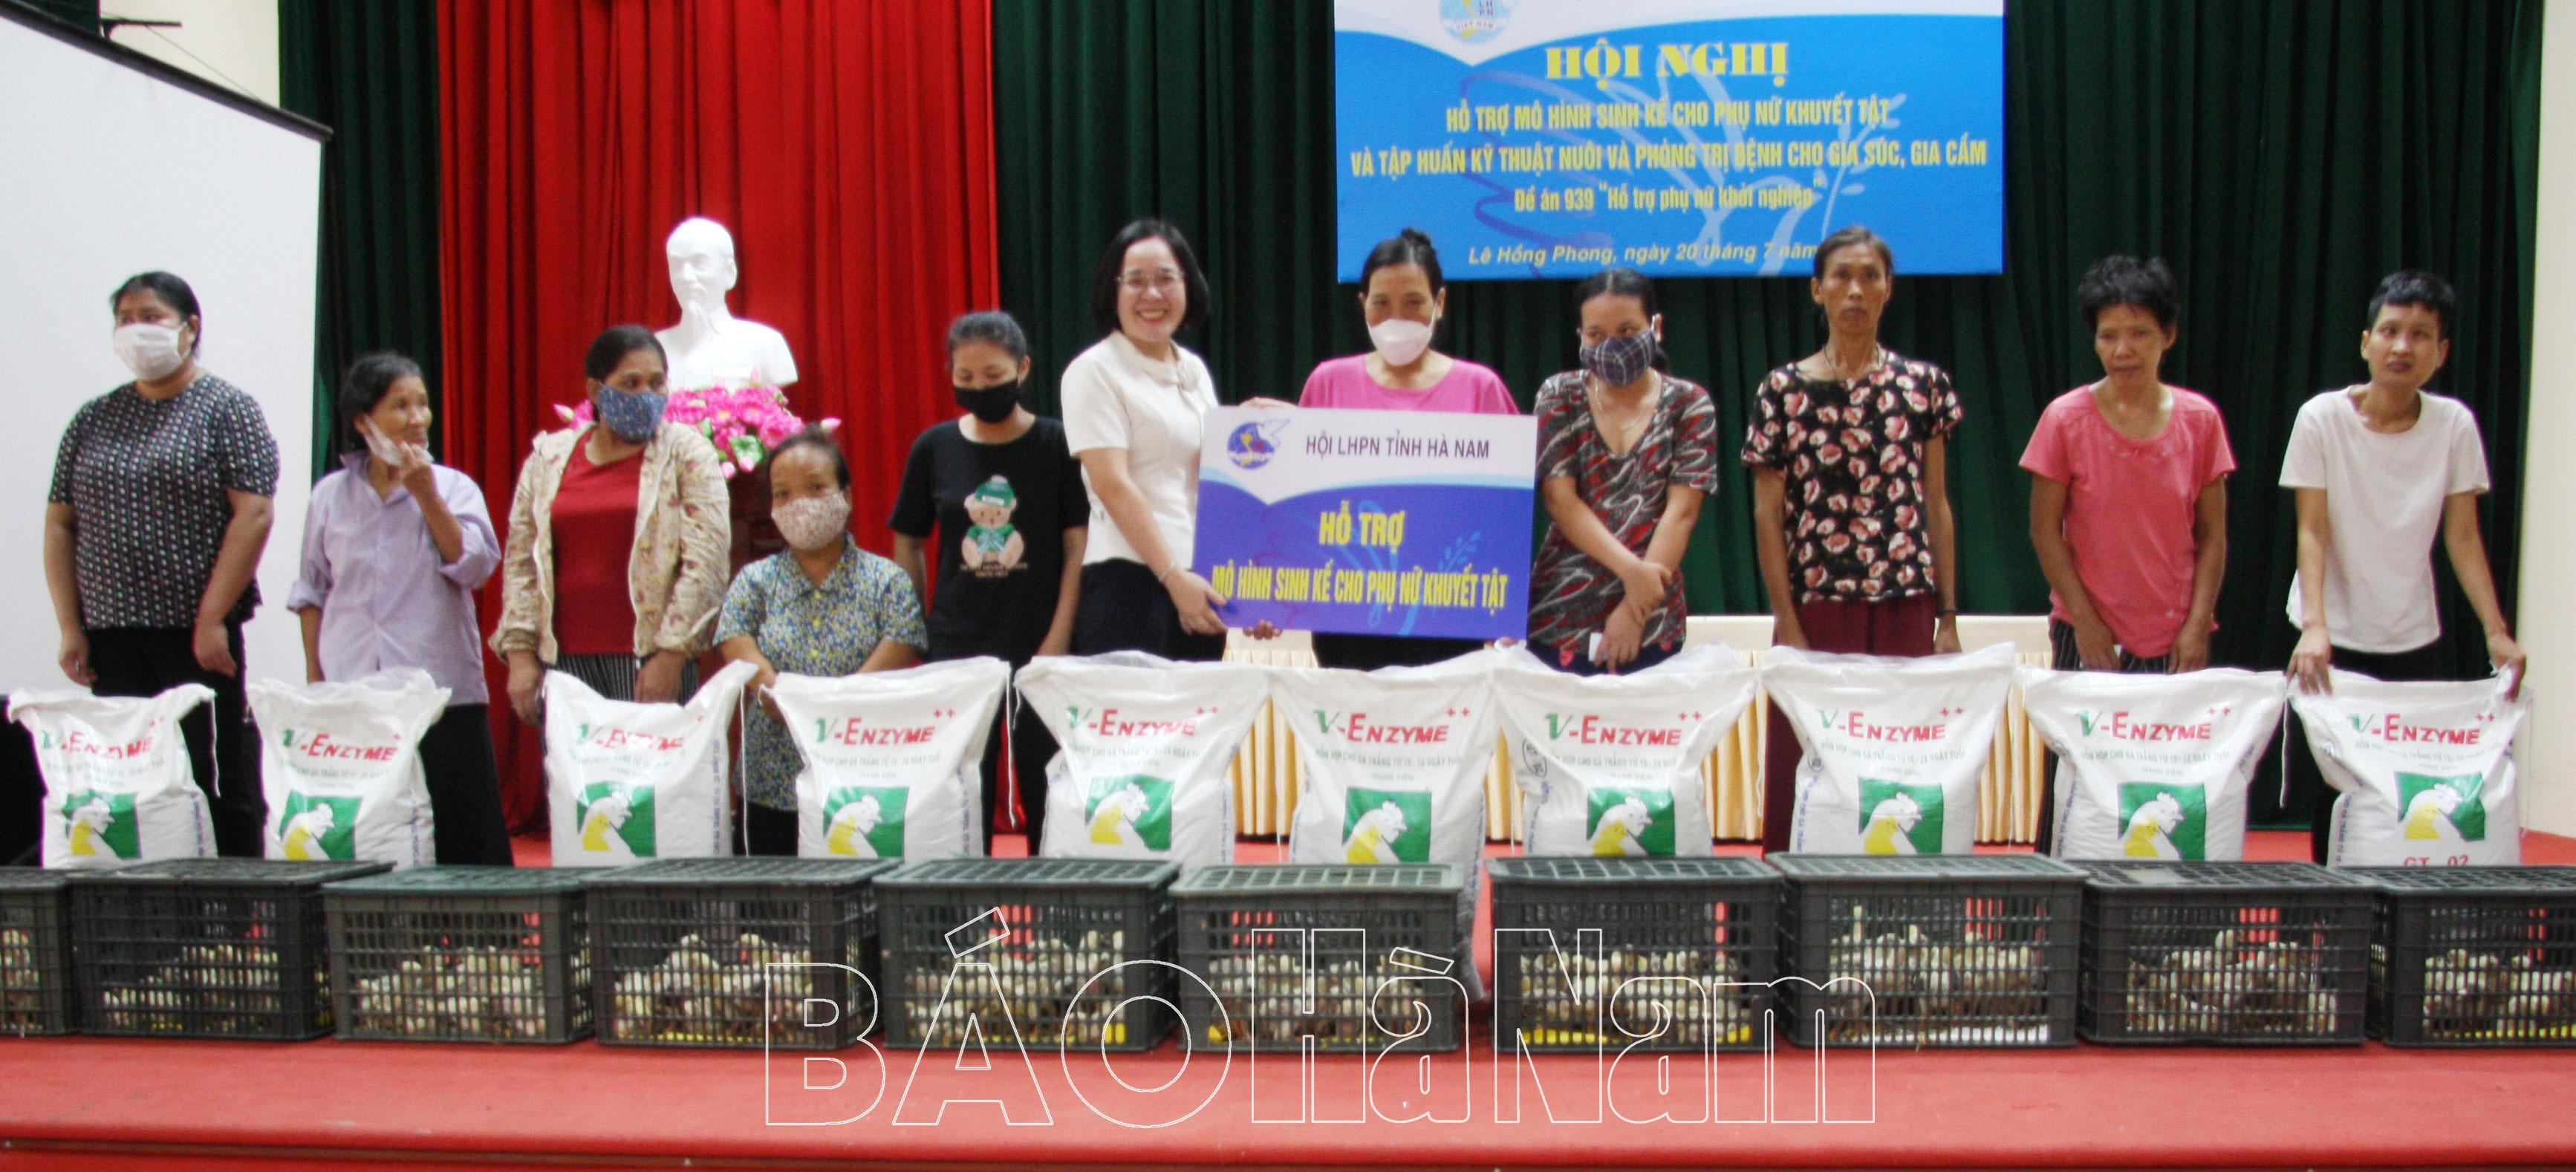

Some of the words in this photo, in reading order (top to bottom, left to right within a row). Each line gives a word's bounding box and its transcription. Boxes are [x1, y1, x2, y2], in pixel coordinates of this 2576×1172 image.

[1546, 37, 1641, 91] HỘI
[1657, 42, 1789, 87] NGHỊ
[1446, 98, 1470, 131] HỖ
[1476, 102, 1509, 136] TRỢ
[1515, 100, 1544, 130] MÔ
[1548, 100, 1592, 129] HÌNH
[1596, 102, 1639, 128] SINH
[1644, 97, 1668, 127] KẾ
[1674, 101, 1708, 127] CHO
[1714, 100, 1750, 131] PHỤ
[1755, 95, 1783, 125] NỮ
[1786, 91, 1854, 125] KHUYẾT
[1858, 93, 1890, 130] TẬT
[1350, 147, 1375, 176] VÀ
[1379, 145, 1412, 180] TẬP
[1417, 140, 1466, 174] HUẤN
[1471, 142, 1494, 172] KỸ
[1498, 141, 1554, 176] THUẬT
[1559, 140, 1602, 171] NUÔI
[1607, 140, 1631, 170] VÀ
[1636, 138, 1696, 169] PHÒNG
[1702, 142, 1730, 172] TRỊ
[1734, 137, 1783, 173] BỆNH
[1787, 141, 1824, 167] CHO
[1828, 140, 1858, 166] GIA
[1864, 135, 1905, 168] SÚC,
[1910, 140, 1941, 166] GIA
[1540, 186, 1561, 211] án
[1564, 187, 1594, 210] 939
[1633, 186, 1655, 214] trợ
[1660, 186, 1689, 213] phụ
[1694, 185, 1714, 208] nữ
[1468, 245, 1492, 264] Lê
[1497, 244, 1546, 267] Hồng
[1552, 244, 1618, 266] Phong,
[1624, 244, 1670, 267] ngày
[1676, 243, 1697, 259] 20
[1703, 241, 1757, 265] tháng
[1763, 243, 1775, 259] 7
[1306, 430, 1333, 459] HỘI
[1338, 436, 1380, 456] LHPN
[1386, 429, 1422, 458] TỈNH
[1428, 433, 1449, 458] HÀ
[1454, 440, 1490, 459] NAM
[1318, 499, 1352, 545] HỖ
[1359, 510, 1406, 554] TRỢ
[1211, 559, 1235, 599] MÔ
[1237, 559, 1272, 601] HÌNH
[1274, 567, 1310, 601] SINH
[1312, 559, 1335, 603] KẾ
[1335, 570, 1364, 603] CHO
[1367, 570, 1397, 612] PHỤ
[1399, 566, 1424, 605] NỮ
[1423, 563, 1479, 608] KHUYẾT
[1482, 568, 1509, 616] TẬT
